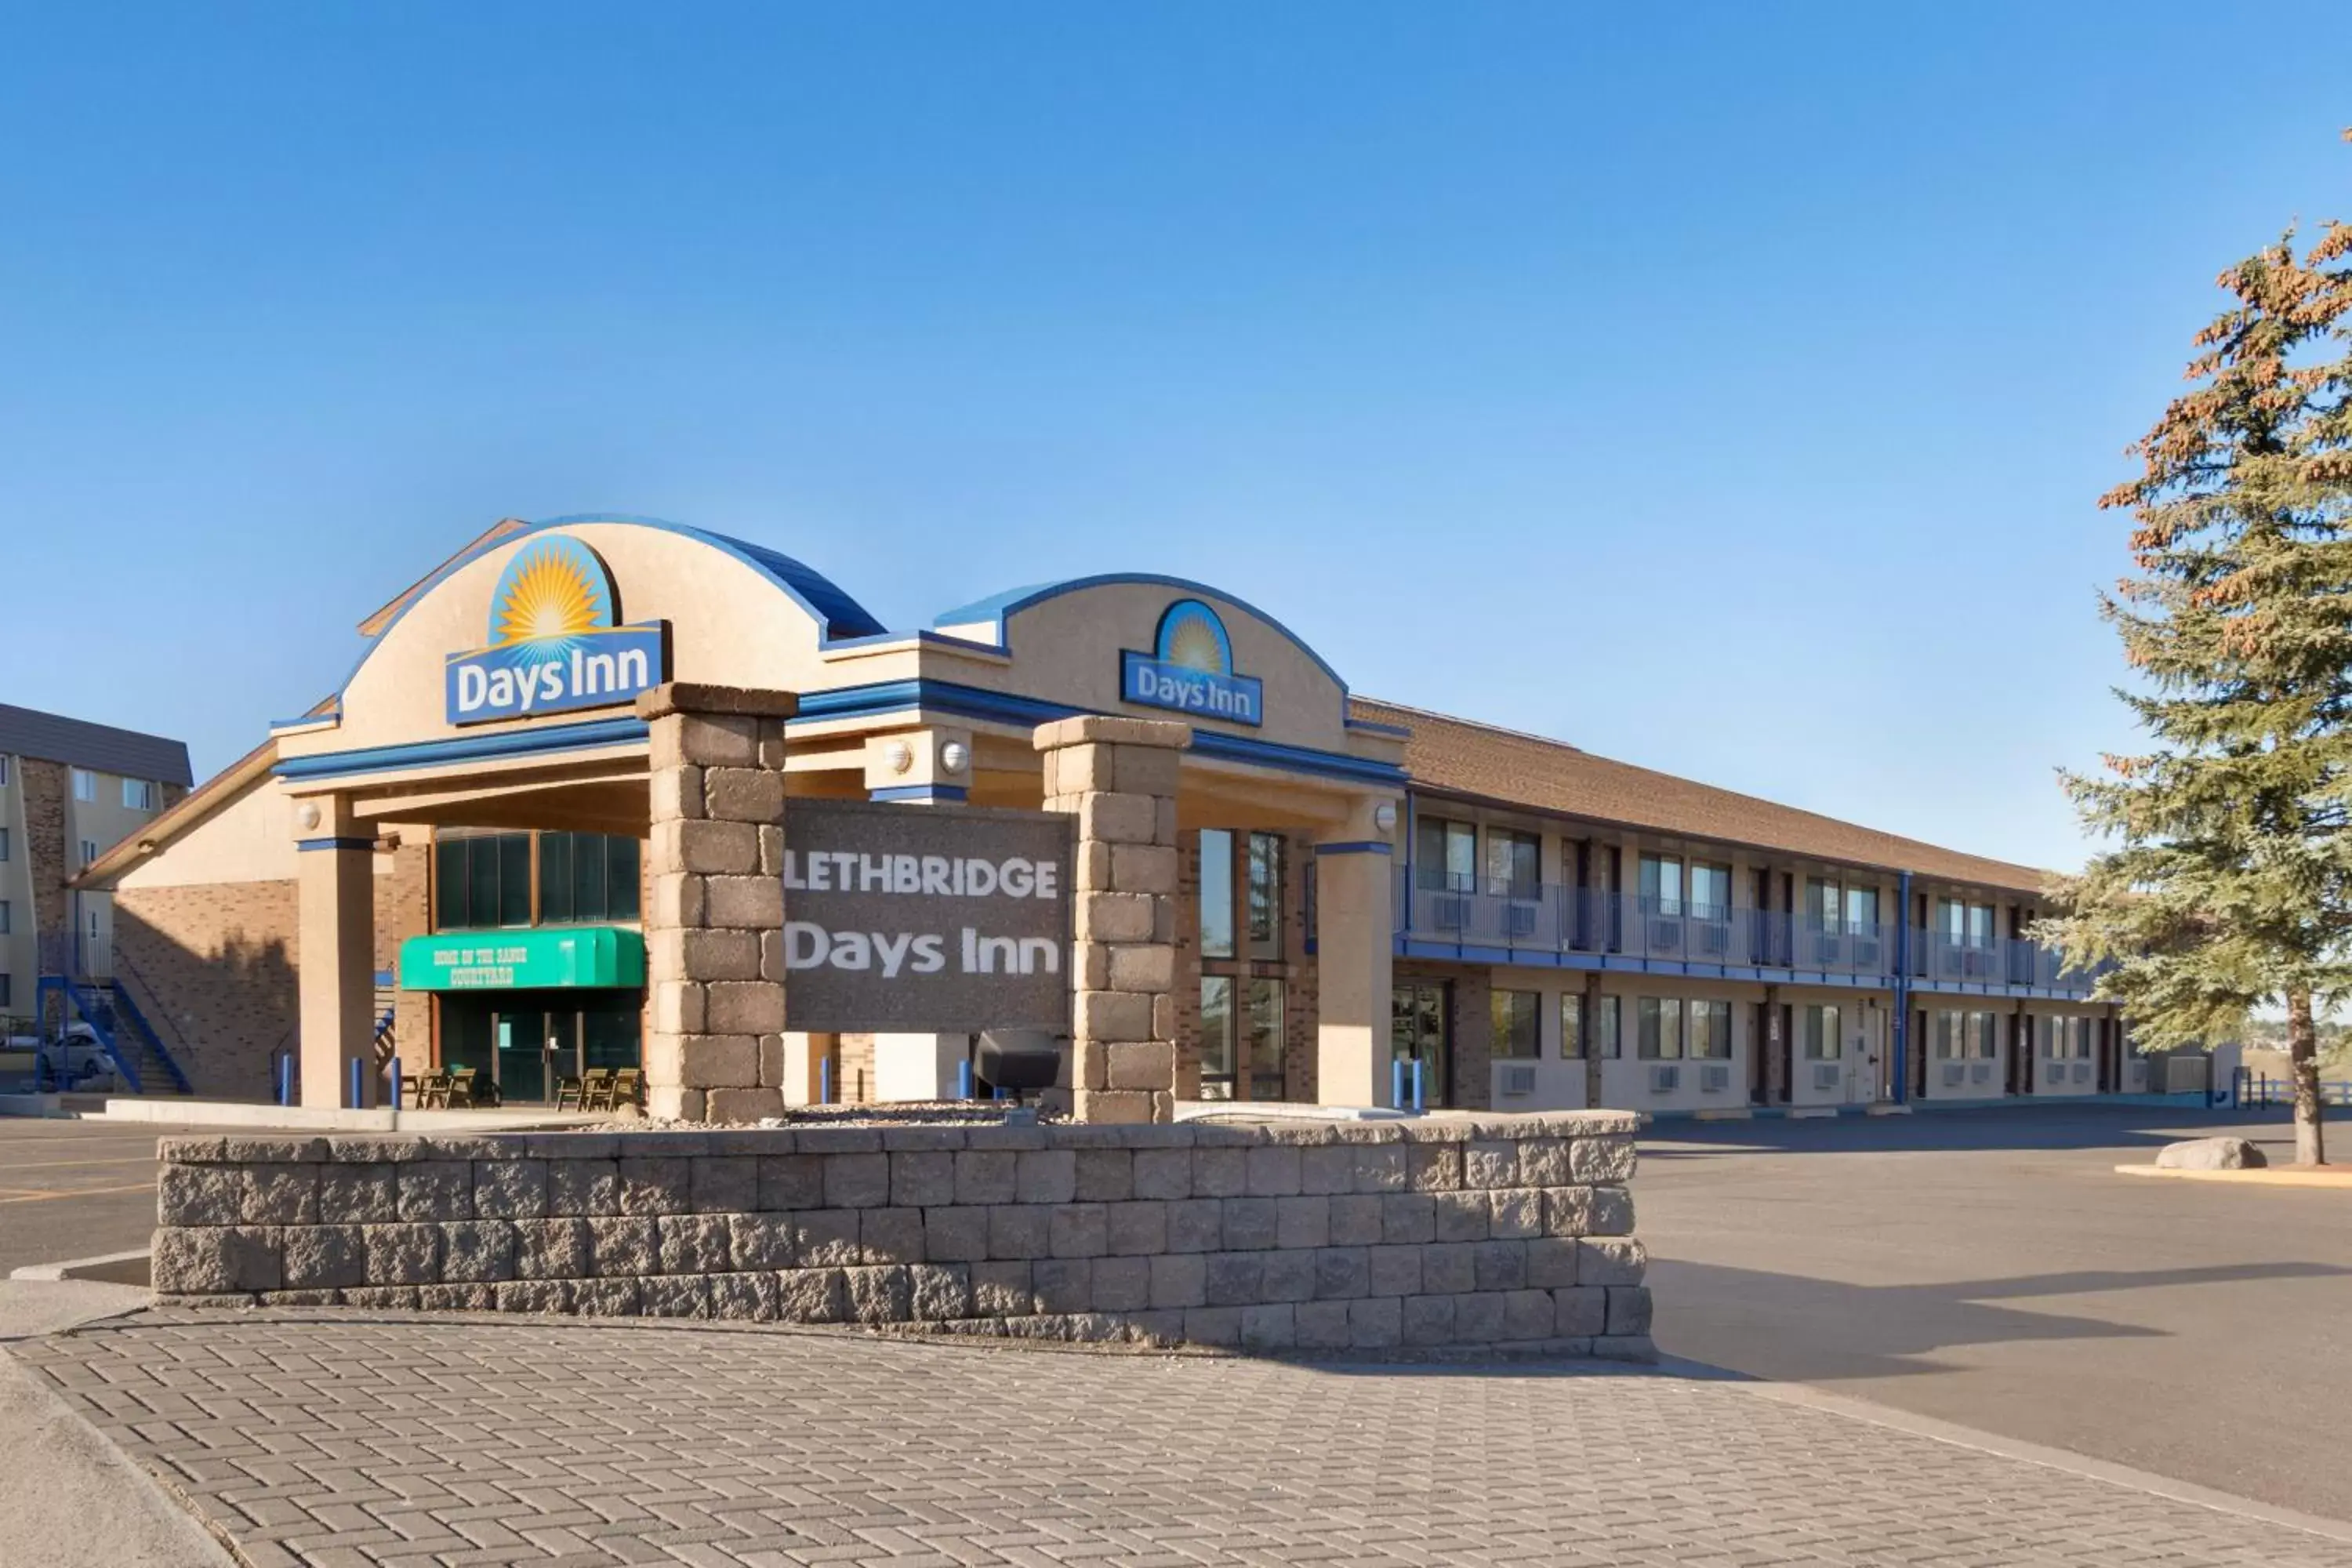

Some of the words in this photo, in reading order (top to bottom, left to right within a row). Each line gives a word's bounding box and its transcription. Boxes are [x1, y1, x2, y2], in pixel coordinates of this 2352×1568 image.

[459, 661, 563, 712] Days
[572, 648, 648, 696] Inn
[1138, 666, 1203, 707] Days
[1209, 682, 1250, 715] Inn
[784, 849, 1058, 898] LETHBRIDGE
[784, 921, 946, 978] Days
[961, 926, 1059, 975] Inn
